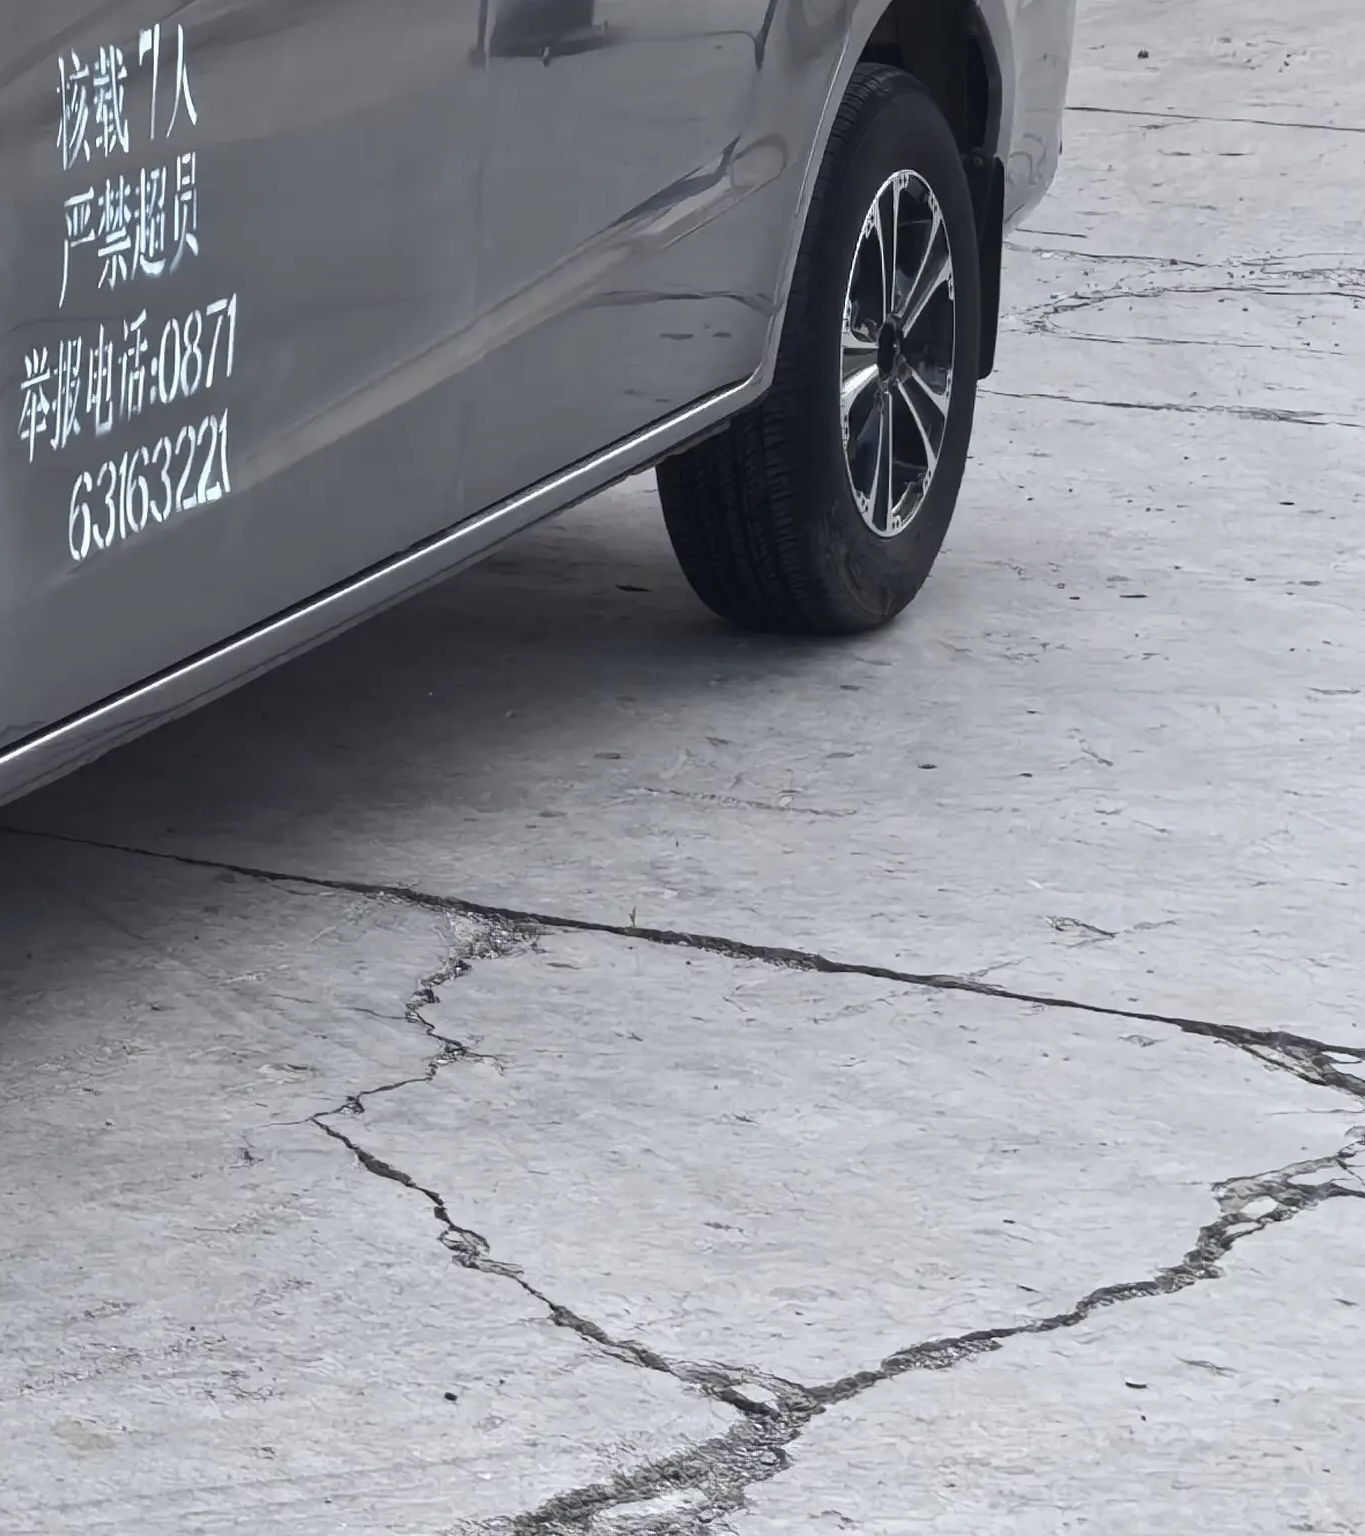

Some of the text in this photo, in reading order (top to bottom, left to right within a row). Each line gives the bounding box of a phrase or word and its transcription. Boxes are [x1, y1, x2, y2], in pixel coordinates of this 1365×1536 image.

[58, 152, 199, 308] 严禁超员
[68, 408, 232, 562] 63163221
